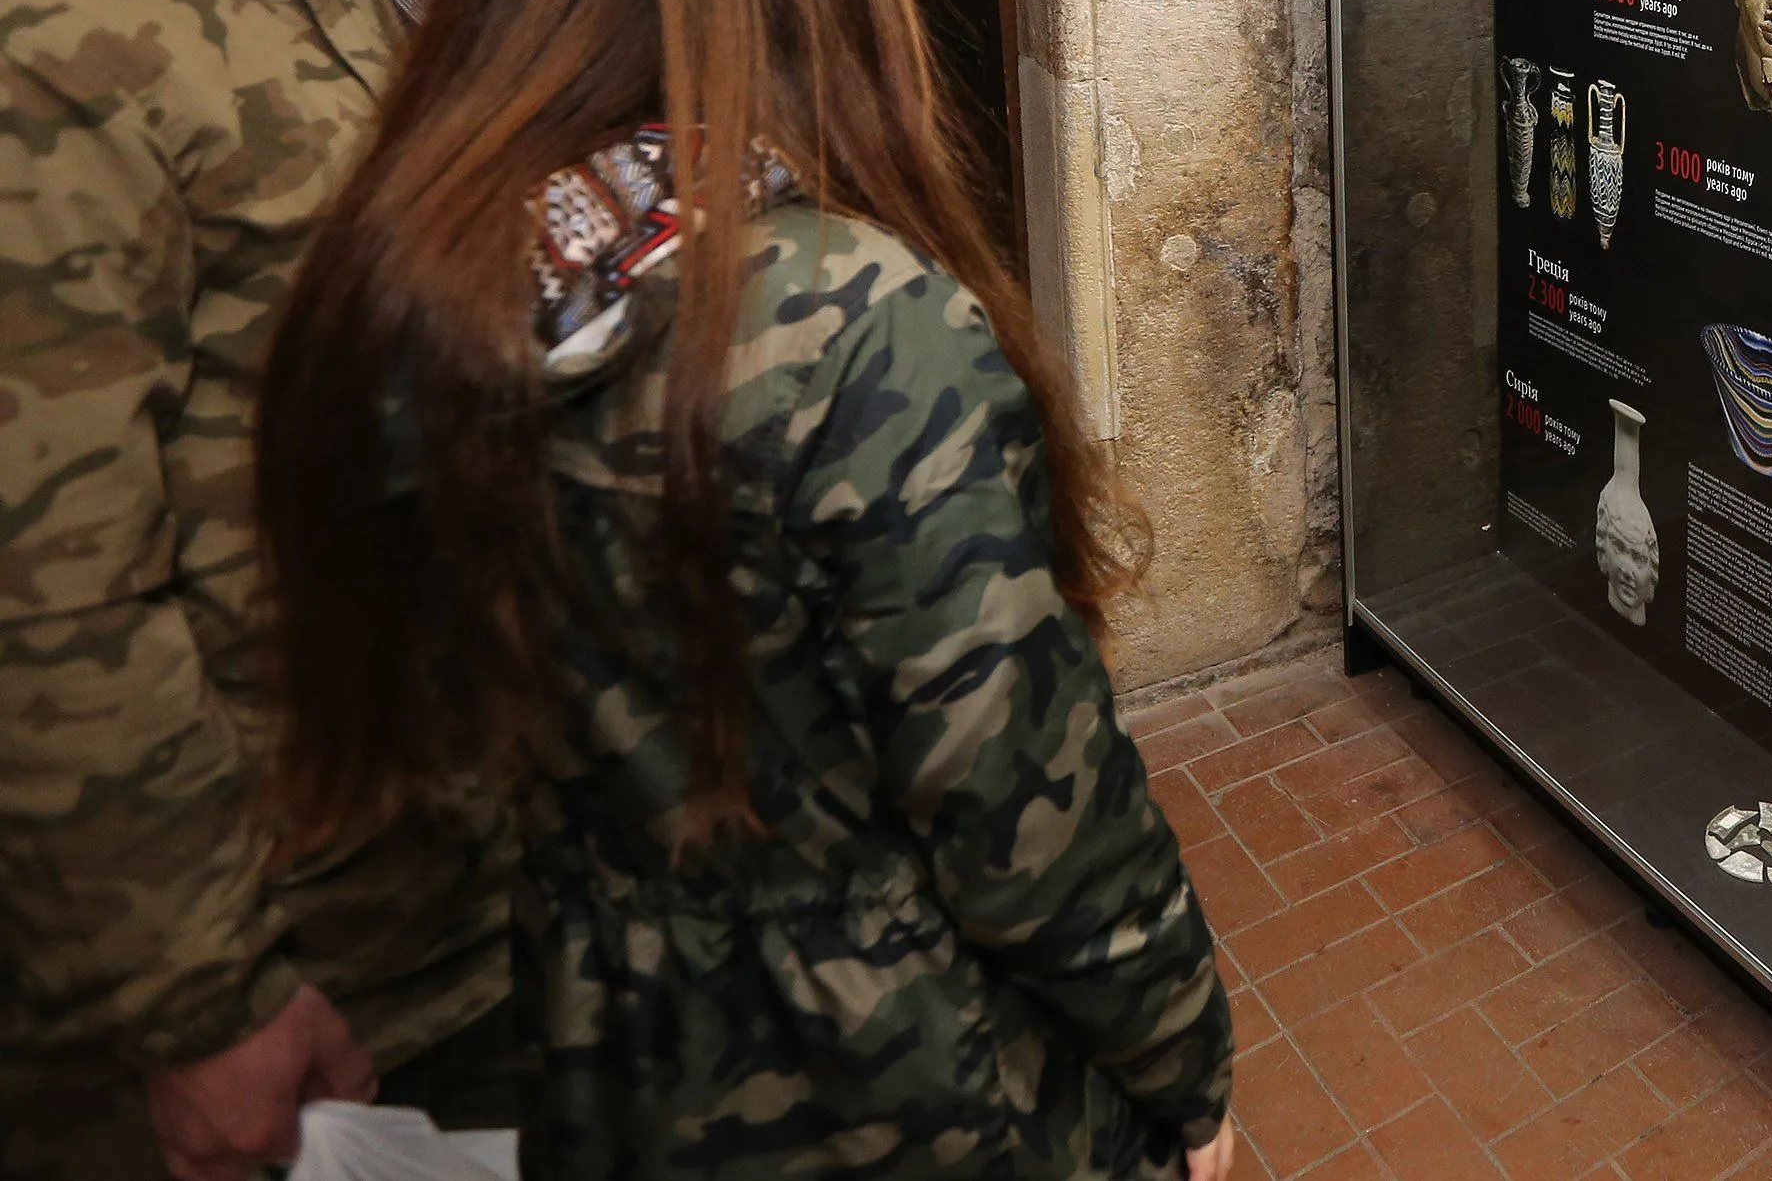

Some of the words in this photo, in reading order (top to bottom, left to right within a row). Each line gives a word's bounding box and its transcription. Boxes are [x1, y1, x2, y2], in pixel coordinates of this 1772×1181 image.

[1662, 2, 1678, 18] ago
[1656, 142, 1664, 170] 3
[1670, 146, 1701, 183] 000
[1706, 158, 1731, 177] років
[1731, 166, 1755, 187] тому
[1706, 177, 1730, 195] years
[1731, 186, 1748, 202] ago
[1528, 248, 1569, 282] Греція
[1569, 293, 1588, 310] років
[1589, 302, 1607, 321] тому
[1569, 309, 1587, 327] years
[1589, 319, 1601, 334] ago
[1506, 370, 1539, 402] Сирія
[1544, 414, 1562, 433] років
[1563, 423, 1581, 445] тому
[1544, 430, 1562, 450] years
[1562, 441, 1576, 456] ago
